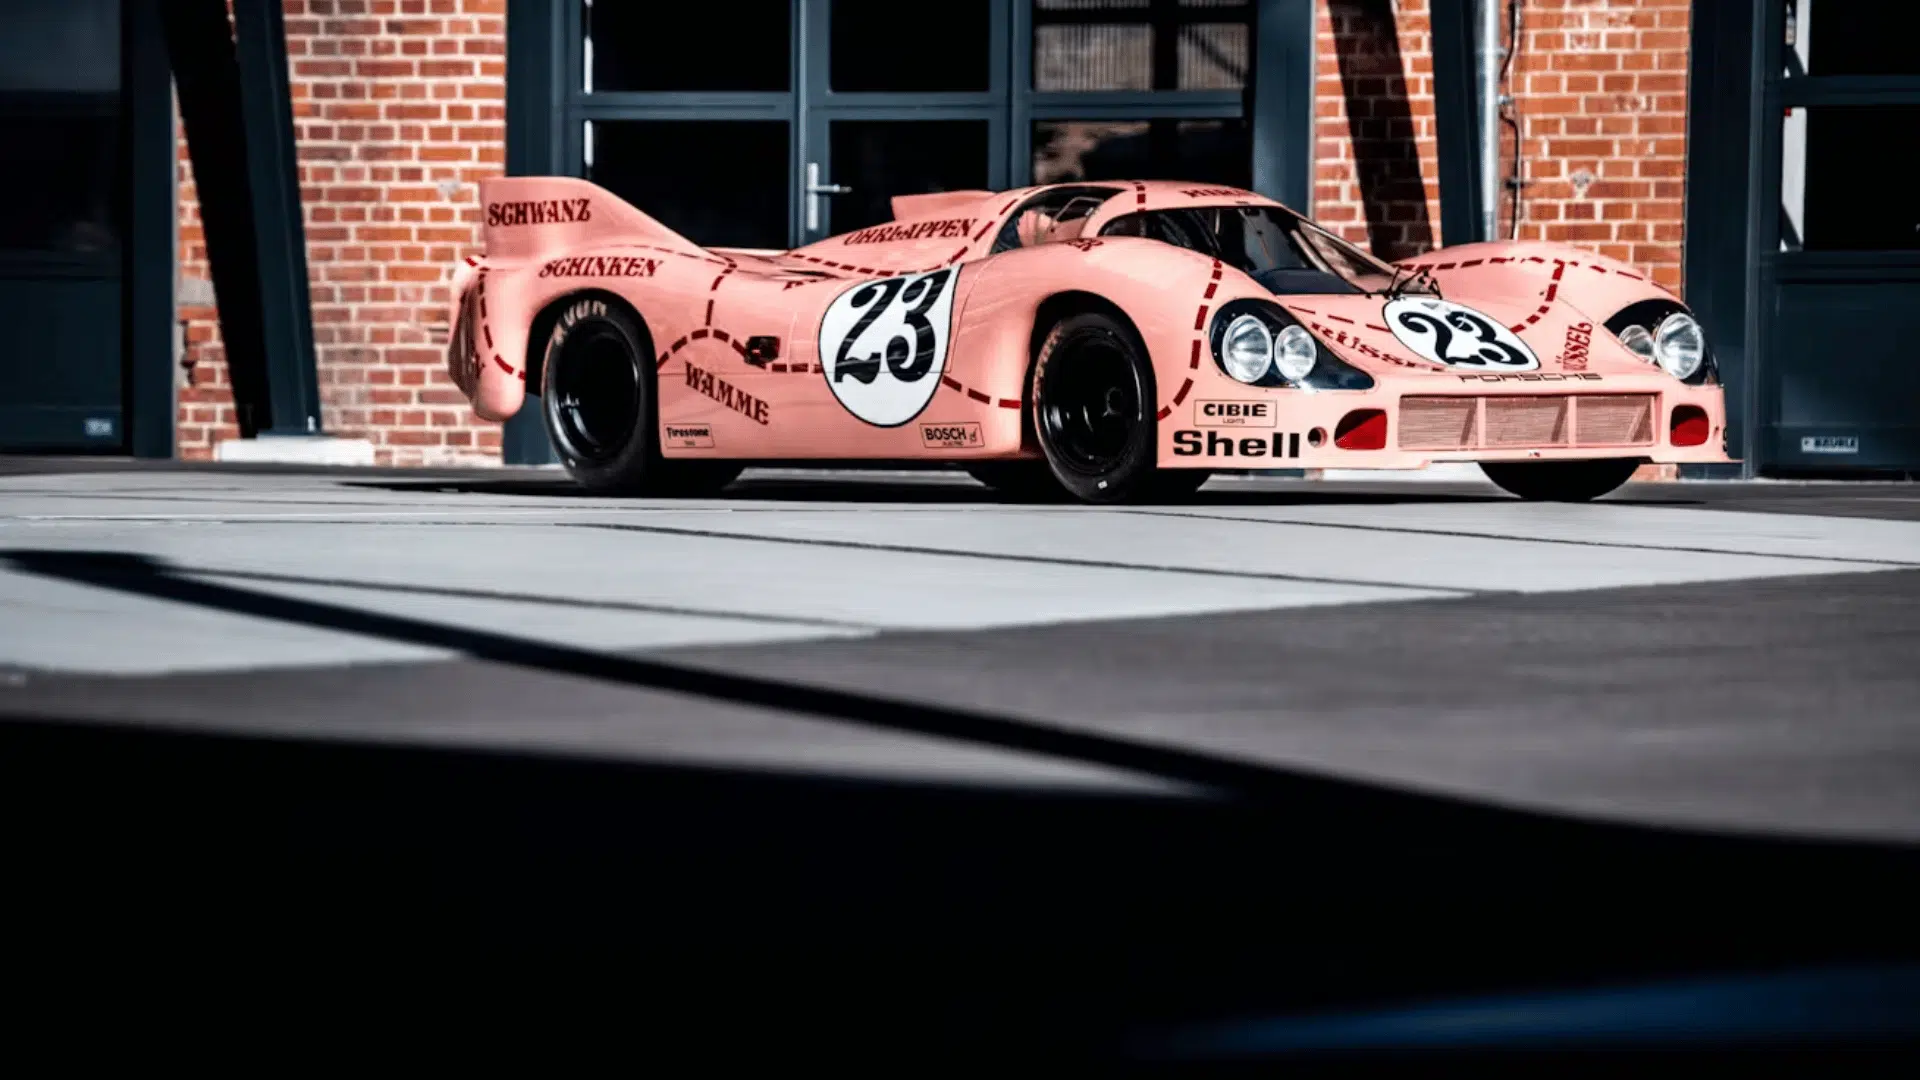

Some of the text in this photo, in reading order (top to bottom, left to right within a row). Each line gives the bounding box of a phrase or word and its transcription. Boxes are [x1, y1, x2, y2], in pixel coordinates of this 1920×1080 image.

[488, 198, 592, 227] SCHWANZ
[538, 255, 665, 279] SCHINKEN
[834, 269, 951, 385] 23
[1398, 311, 1530, 366] 23
[1458, 373, 1603, 382] PORSCHE
[684, 361, 770, 426] WAMME
[925, 427, 967, 441] BOSCH
[1172, 429, 1300, 459] Shell
